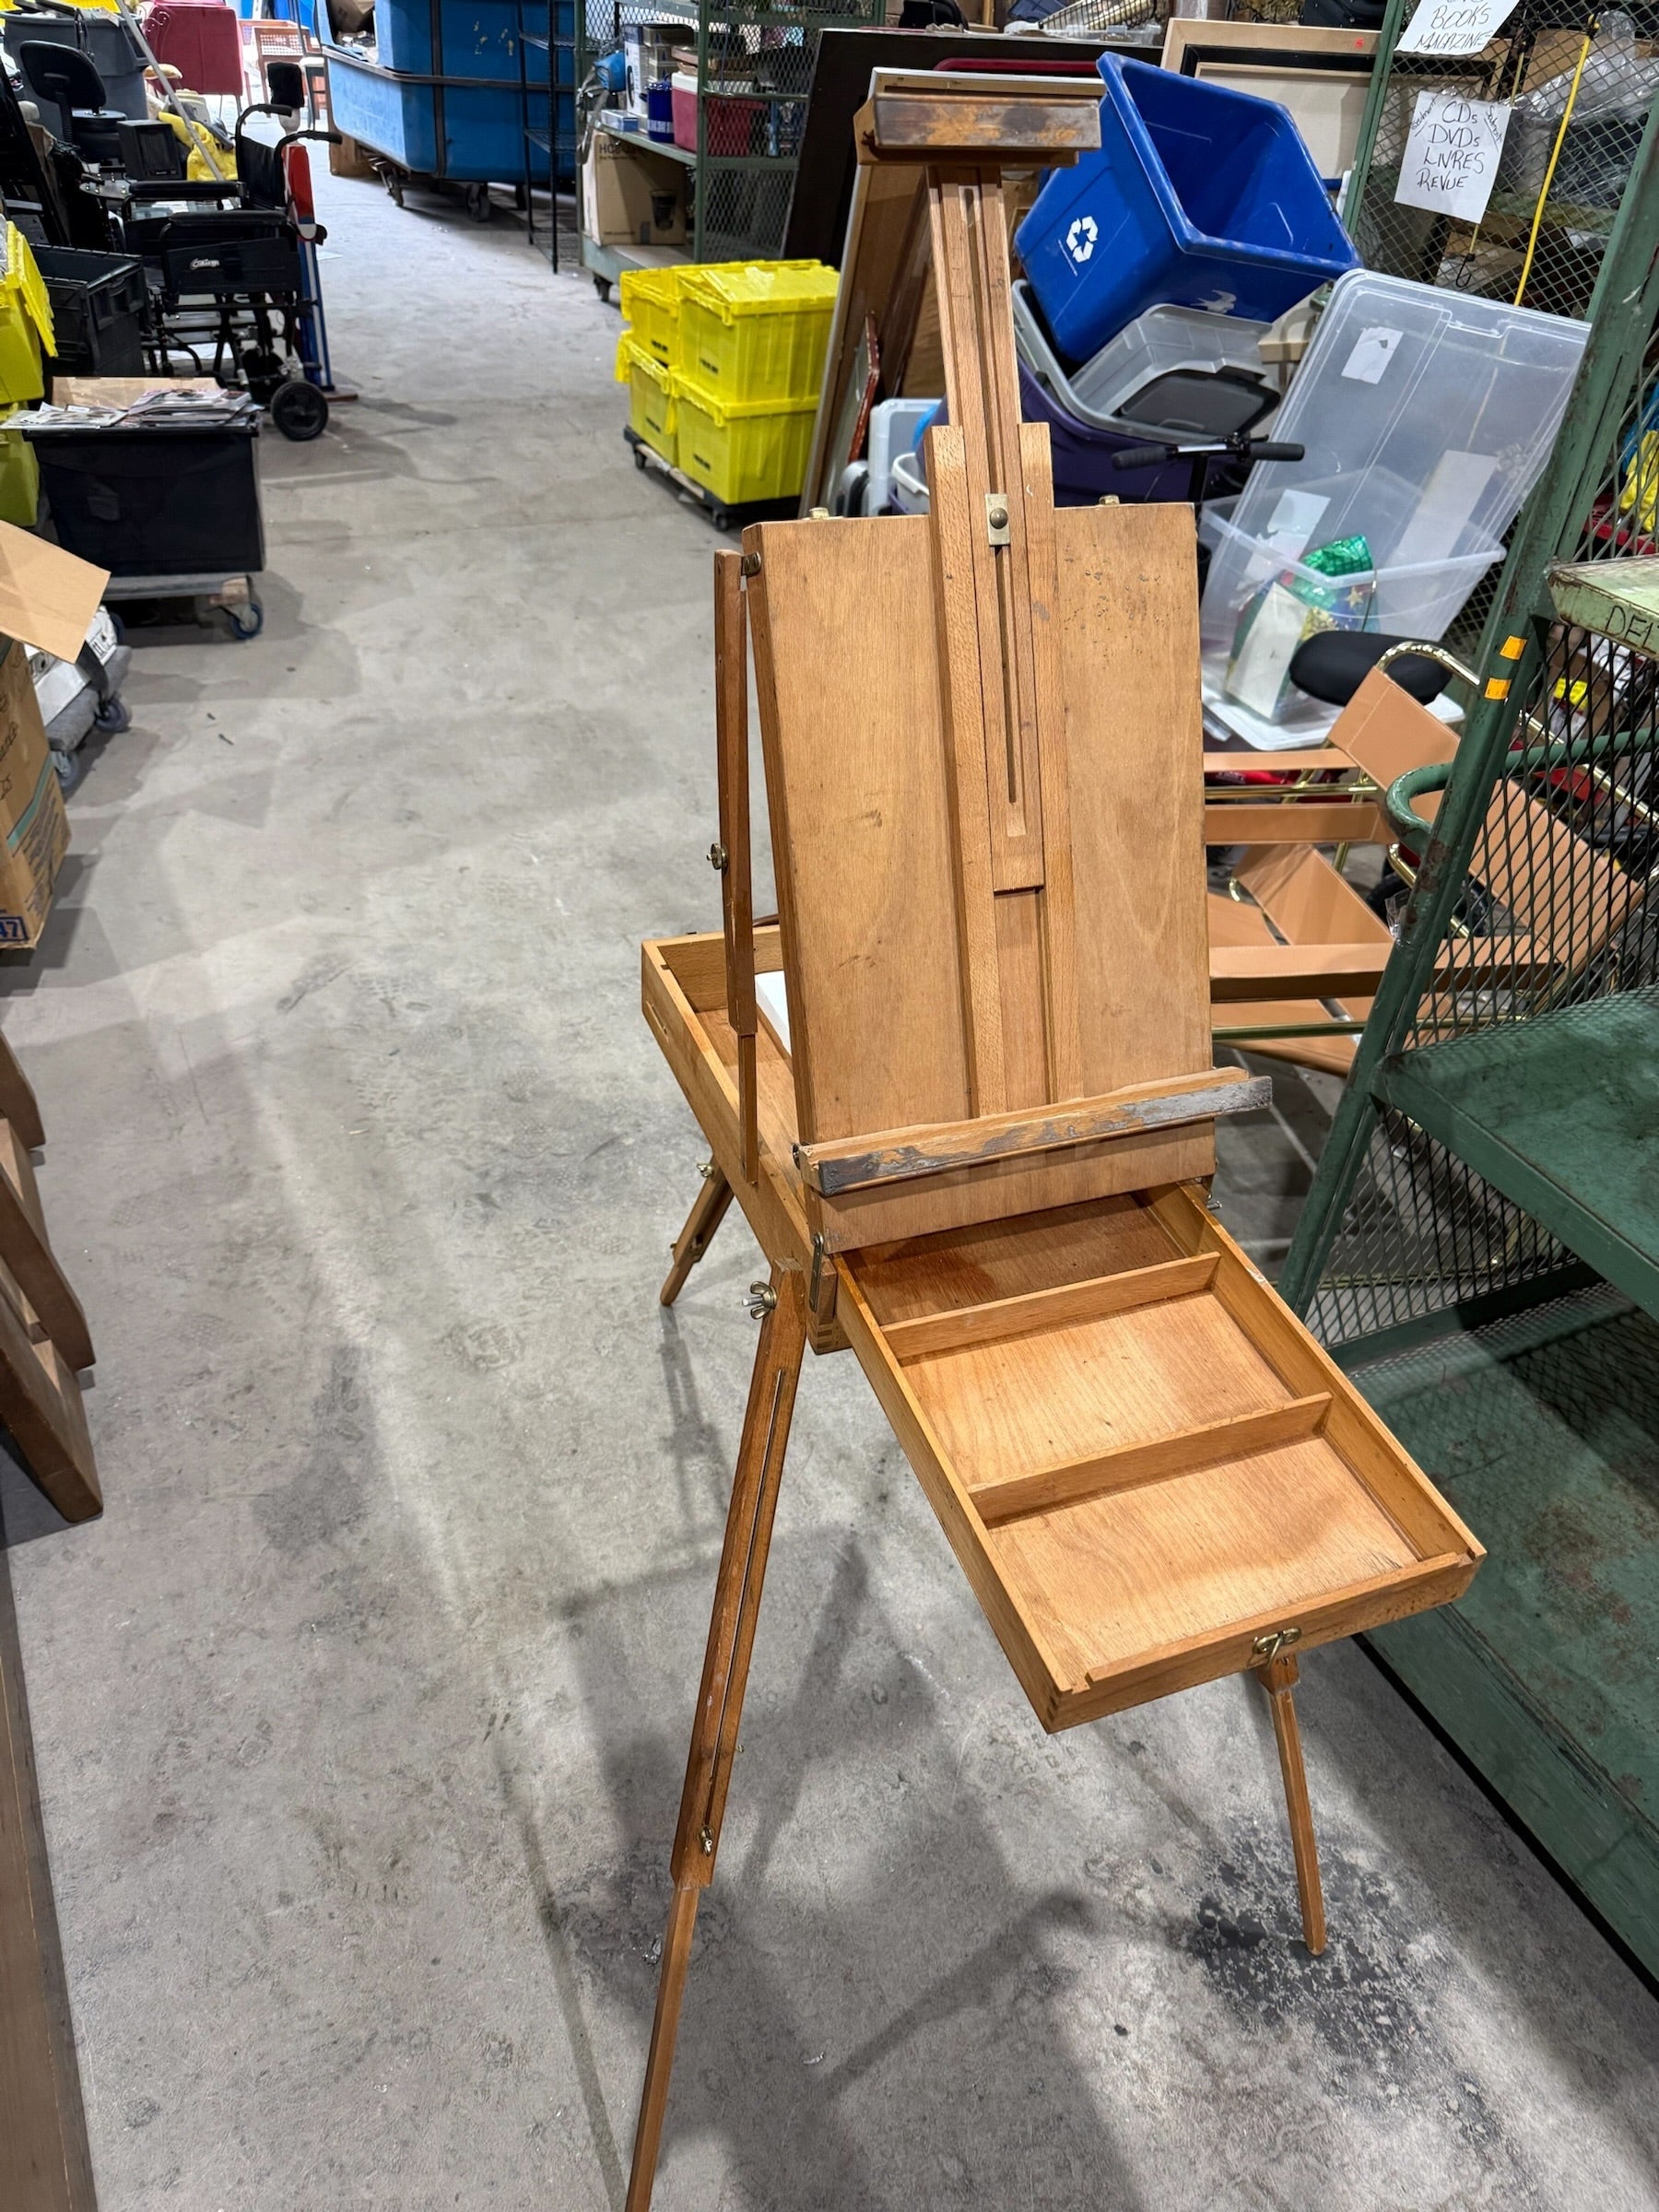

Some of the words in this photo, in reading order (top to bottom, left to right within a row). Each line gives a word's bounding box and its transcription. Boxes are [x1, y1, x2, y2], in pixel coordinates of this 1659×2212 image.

[1430, 3, 1491, 29] BOOKS
[1442, 100, 1477, 124] CDs
[1428, 124, 1480, 147] DVDs
[1424, 147, 1485, 174] LIVRES
[1417, 168, 1468, 192] REVUE
[1605, 605, 1659, 654] DEL
